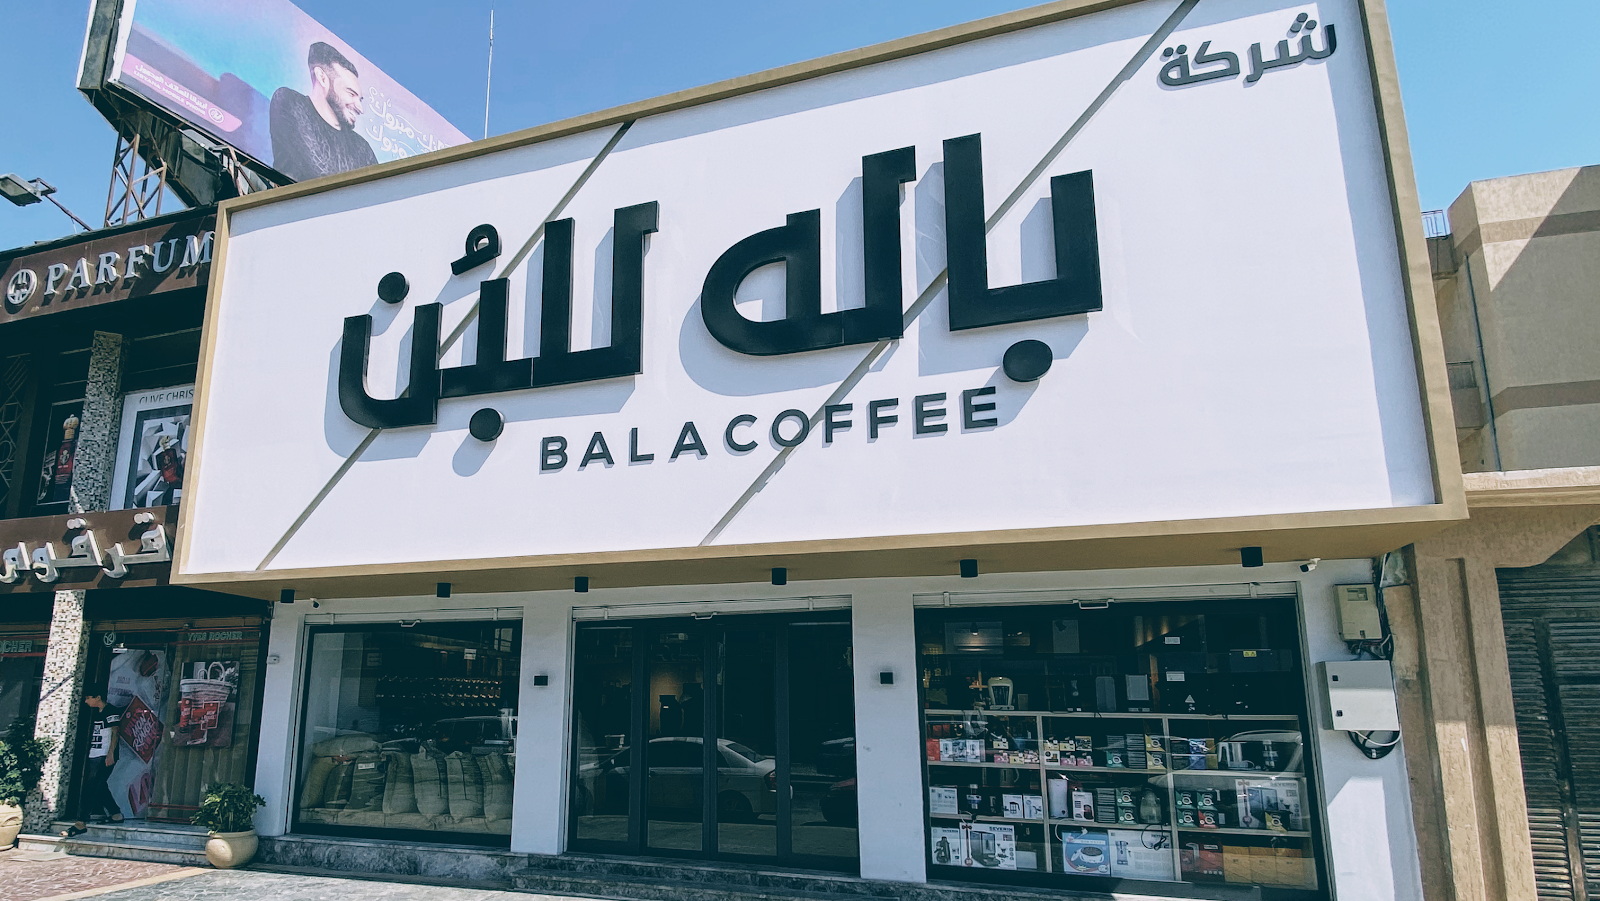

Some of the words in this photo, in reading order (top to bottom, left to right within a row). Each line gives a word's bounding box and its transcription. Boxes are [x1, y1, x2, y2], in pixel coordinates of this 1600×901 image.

[1159, 12, 1337, 86] شركة
[44, 230, 215, 296] PARFUM
[139, 393, 164, 404] CLIVE
[188, 632, 207, 641] YVES
[208, 631, 243, 641] ROCHER
